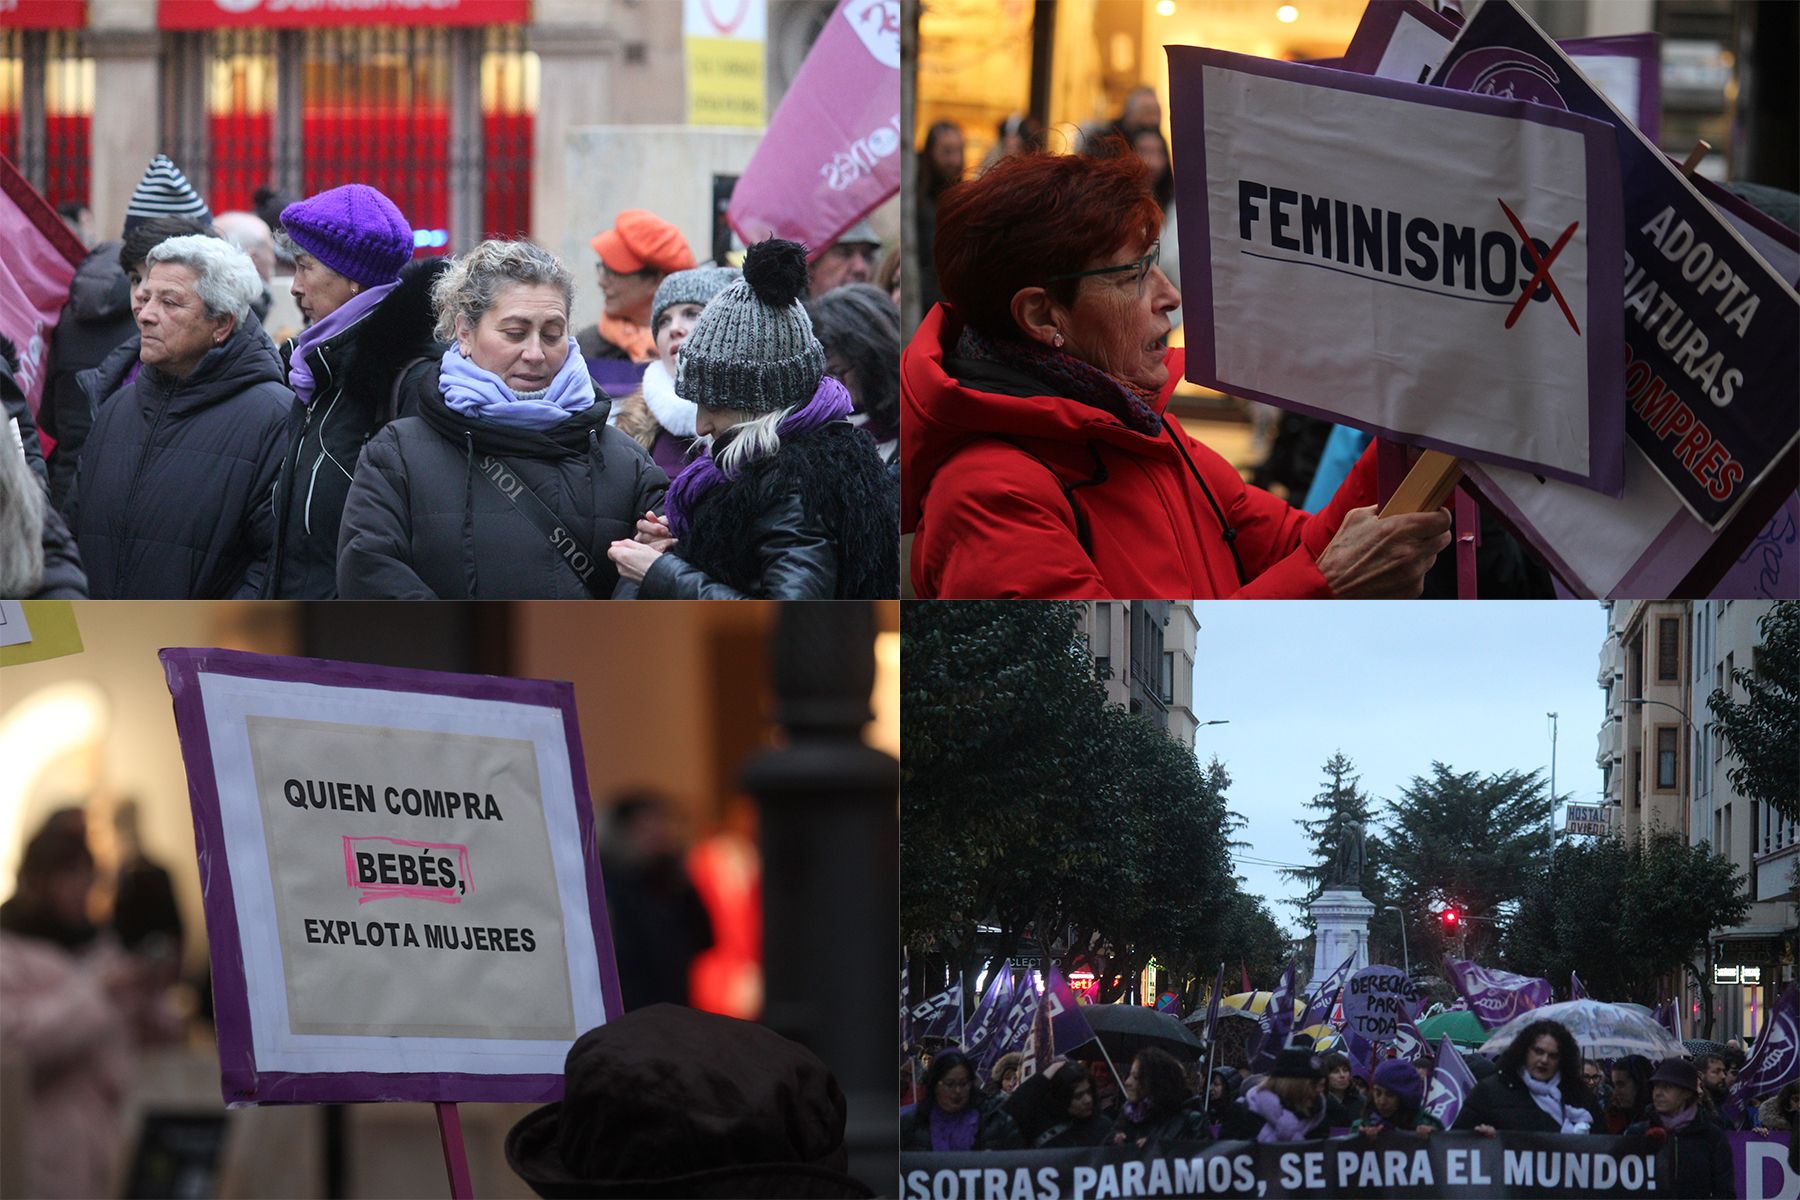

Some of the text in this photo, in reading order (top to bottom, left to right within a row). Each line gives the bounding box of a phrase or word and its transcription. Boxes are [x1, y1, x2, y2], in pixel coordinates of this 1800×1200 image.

[1641, 205, 1760, 338] ADOPTA
[1625, 342, 1744, 501] OMPRES
[480, 455, 524, 503] TOUS
[549, 527, 595, 583] TOUS
[284, 778, 503, 822] QUIEN COMPRA
[1568, 806, 1606, 821] HOSTAL
[1570, 822, 1606, 834] OVIEDO
[357, 848, 466, 894] BEBÉS,
[304, 918, 536, 953] EXPLOTA MUJERES
[1351, 974, 1417, 1002] DERECHOS
[900, 1148, 1657, 1200] SOTRAS PARAMOS, SE PARA EL MUNDO!
